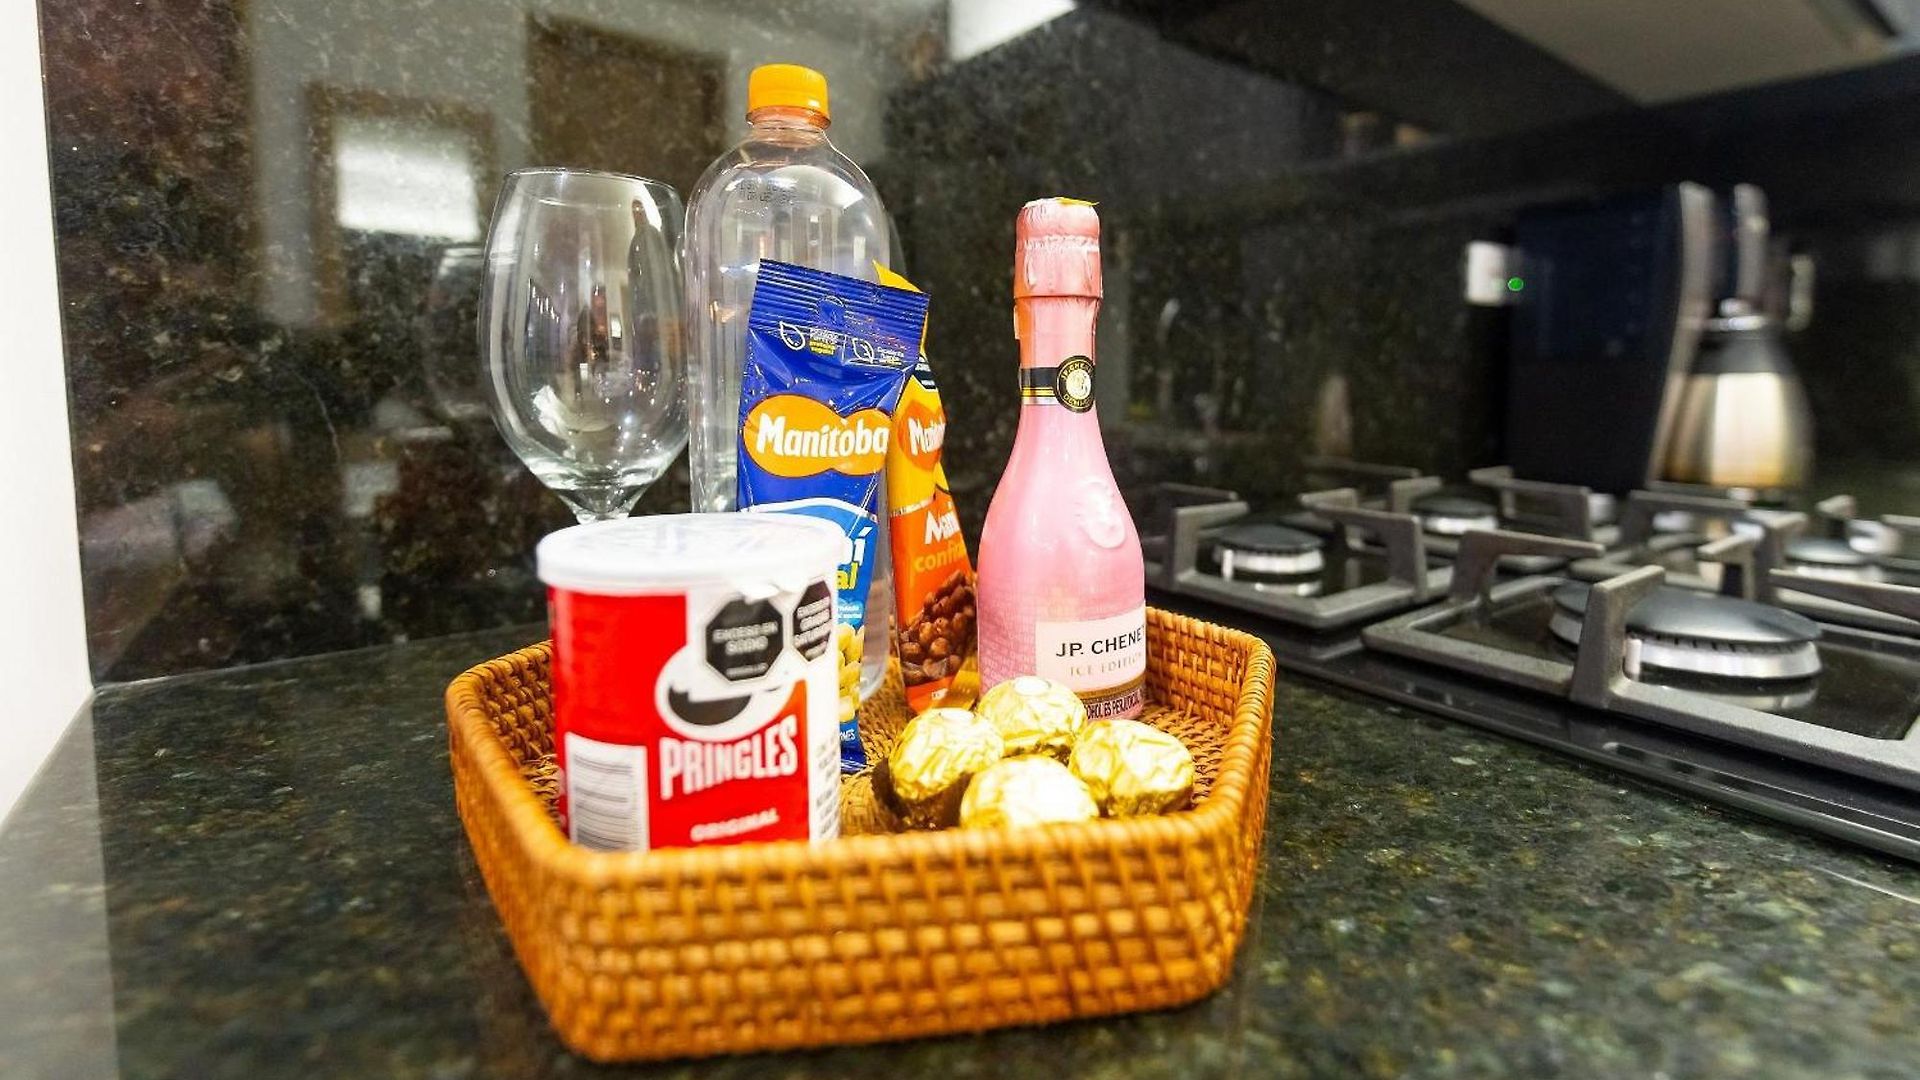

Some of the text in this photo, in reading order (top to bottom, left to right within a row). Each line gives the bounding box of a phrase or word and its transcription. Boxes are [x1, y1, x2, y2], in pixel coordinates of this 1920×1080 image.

[756, 413, 890, 458] Manitoba
[1055, 643, 1084, 657] JP.
[659, 713, 799, 801] PRINGLES
